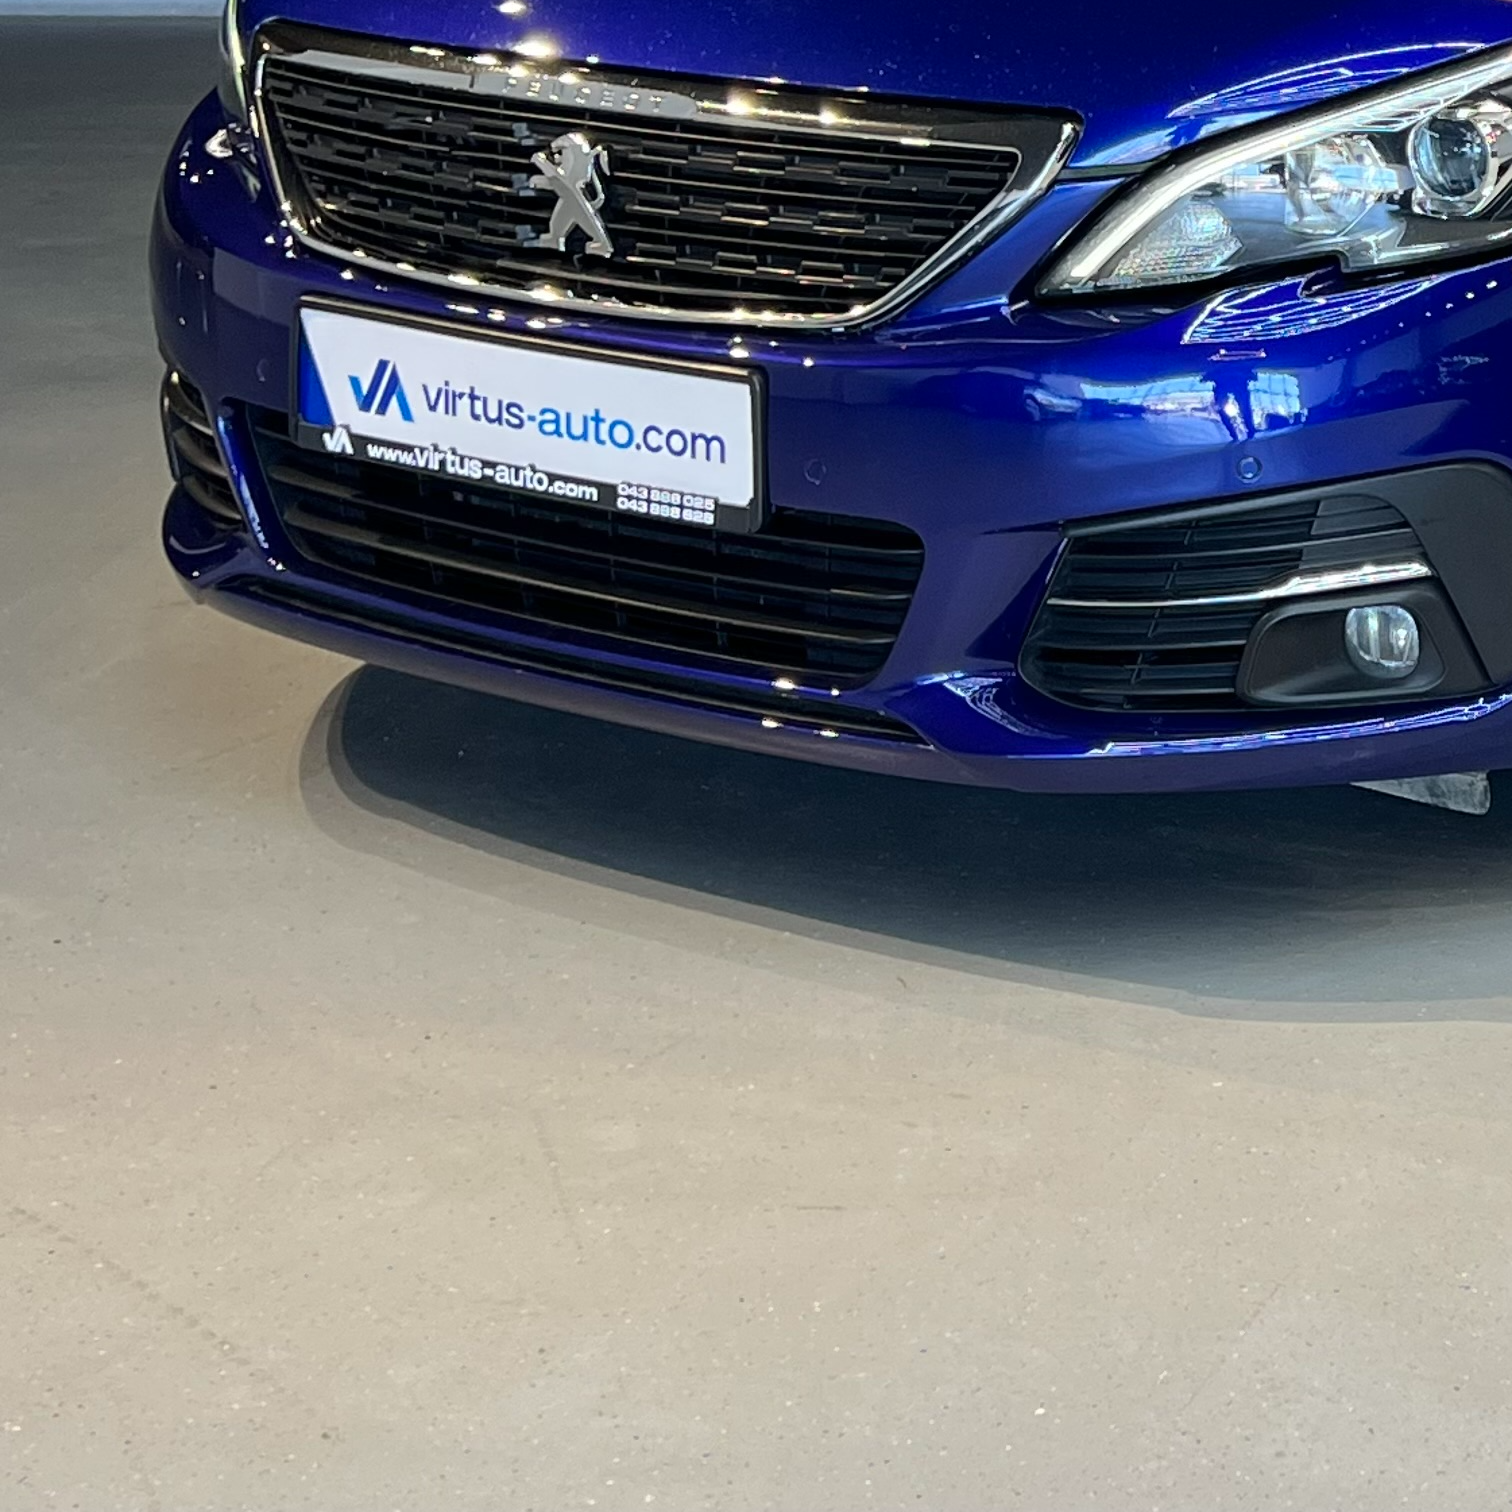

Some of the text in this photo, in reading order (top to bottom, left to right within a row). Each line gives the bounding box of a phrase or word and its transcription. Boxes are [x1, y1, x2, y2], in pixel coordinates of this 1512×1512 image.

[421, 379, 727, 465] virtus-auto.com
[366, 442, 599, 502] www.virtus-auto.com
[617, 483, 648, 499] 043
[616, 496, 648, 513] 043
